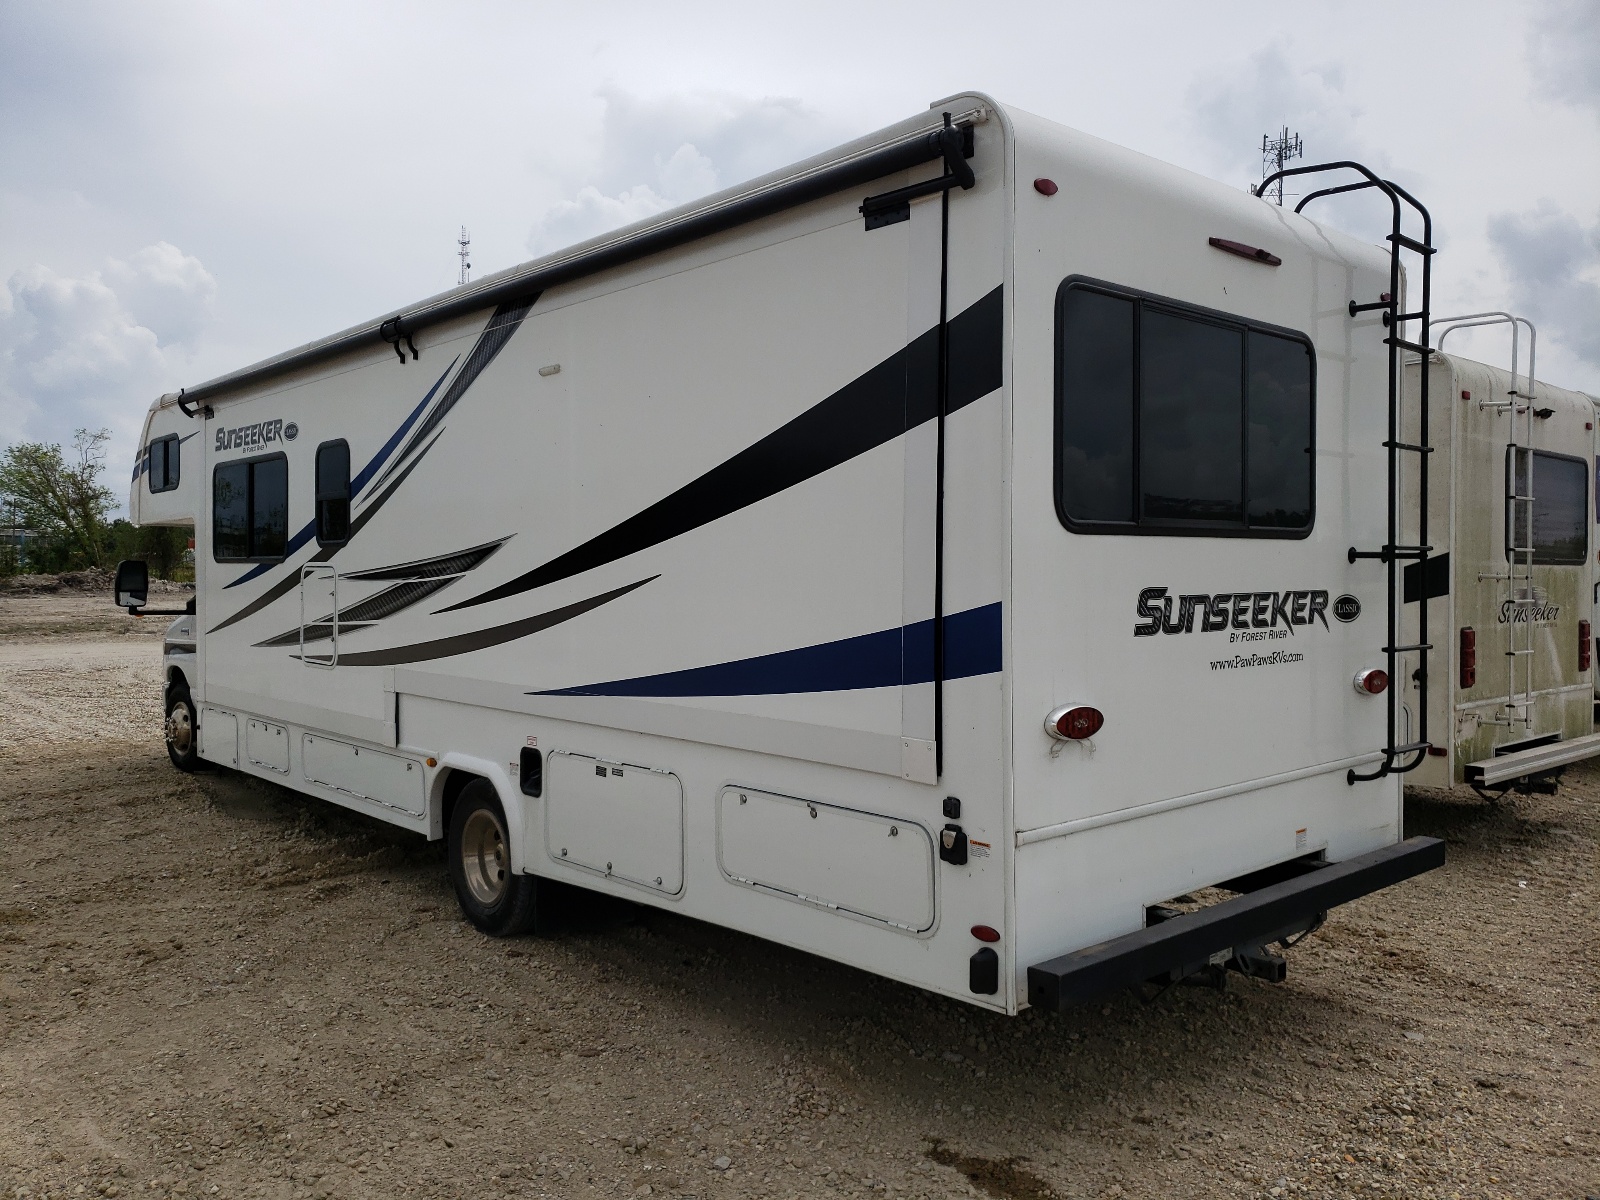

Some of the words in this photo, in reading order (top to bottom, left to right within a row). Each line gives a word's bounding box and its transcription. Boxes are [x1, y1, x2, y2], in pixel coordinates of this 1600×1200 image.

[1241, 631, 1267, 642] FOREST
[1268, 629, 1288, 640] RIVER
[1210, 650, 1304, 671] www.PawPawsRVs.com
